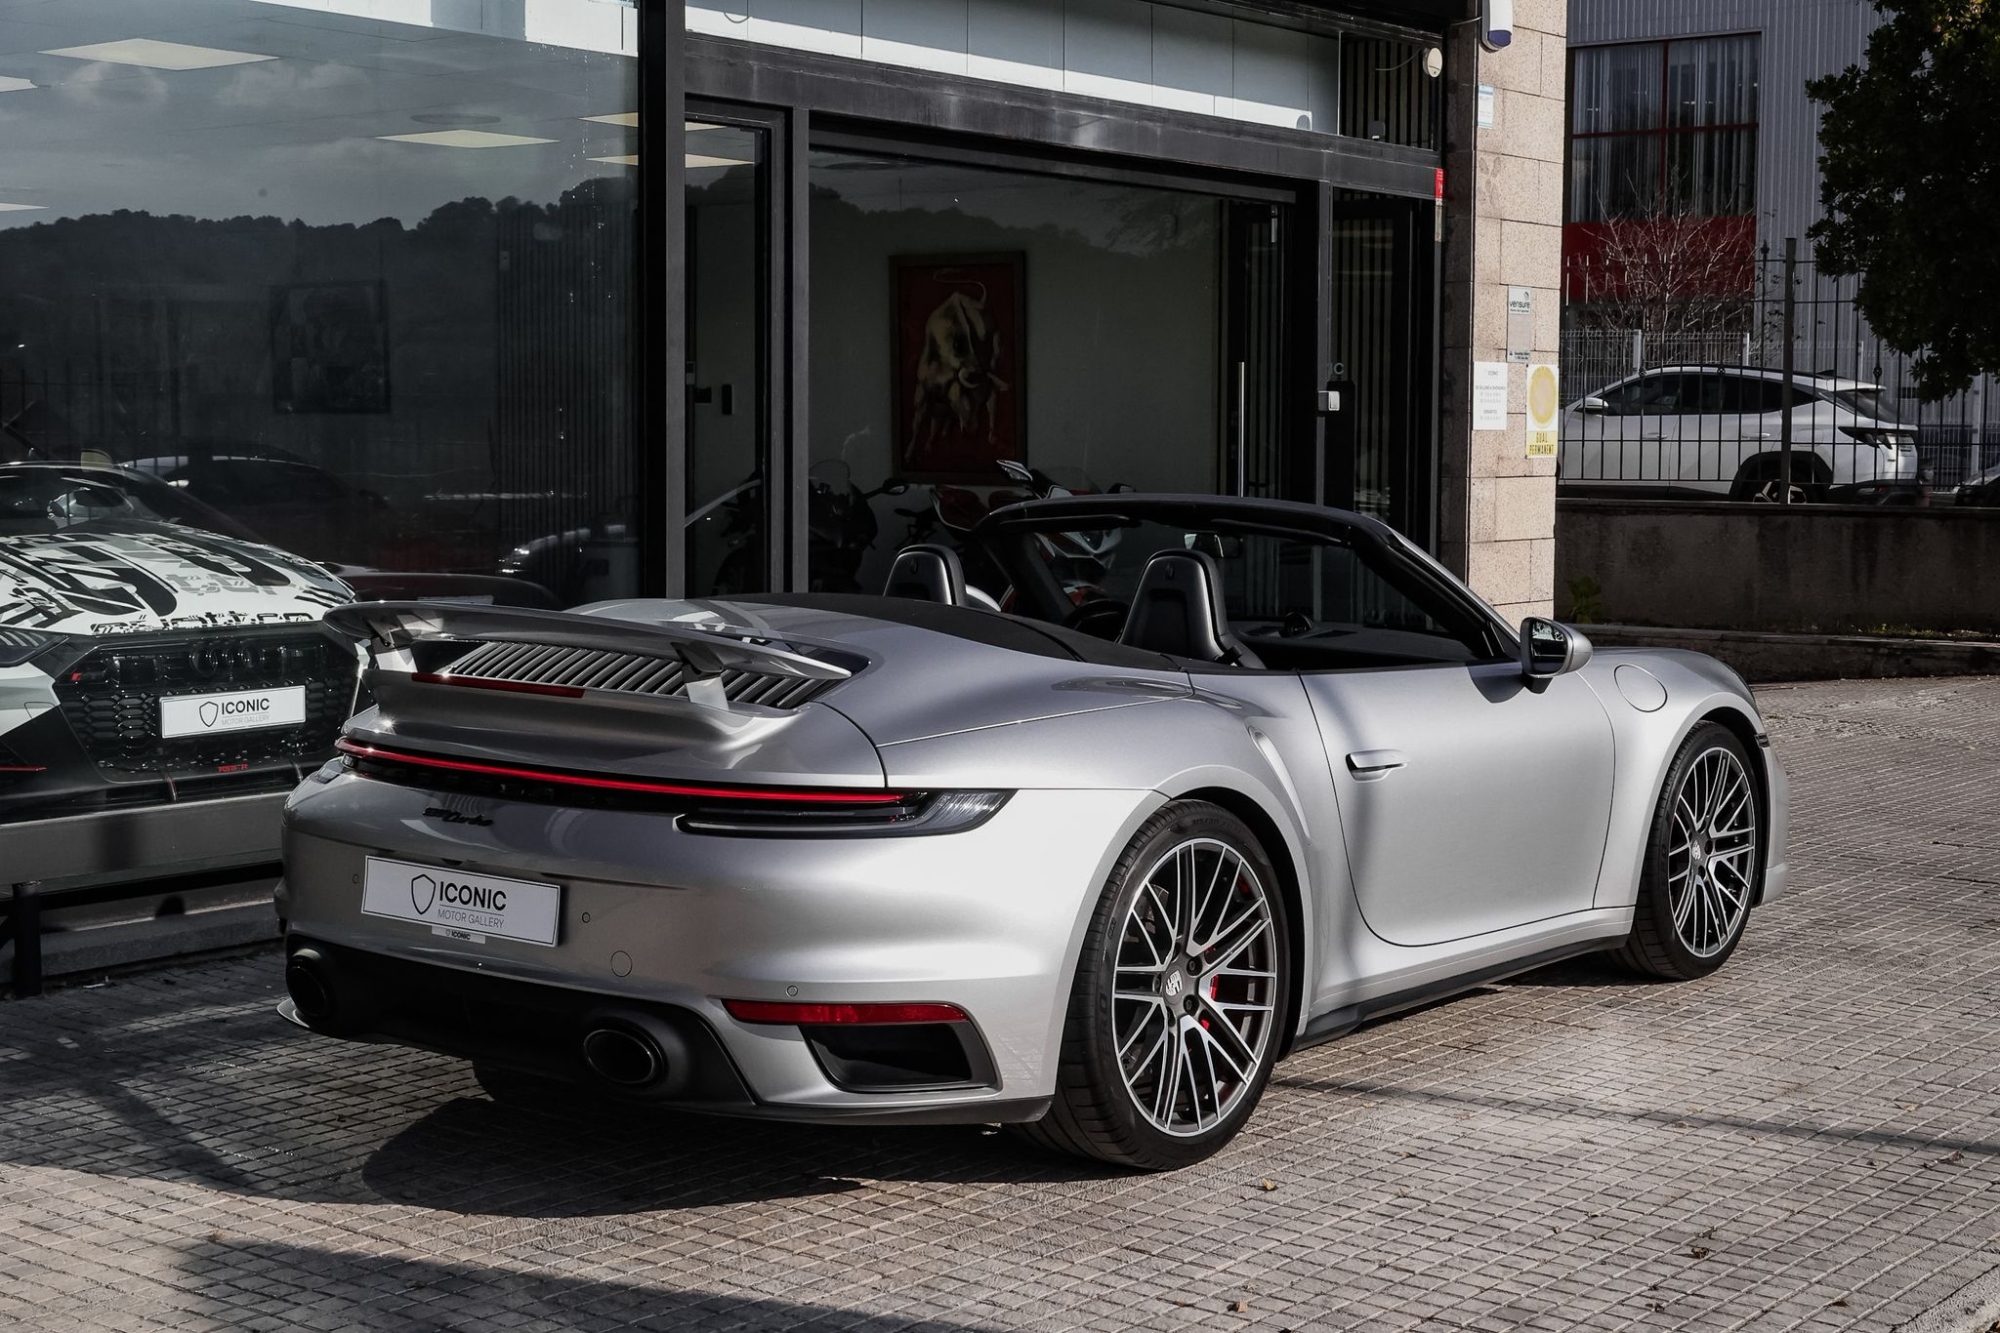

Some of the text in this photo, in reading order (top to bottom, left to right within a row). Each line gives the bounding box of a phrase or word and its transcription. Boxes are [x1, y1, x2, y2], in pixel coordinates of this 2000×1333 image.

[1529, 444, 1554, 455] PERMANENT
[222, 698, 270, 715] ICONIC
[222, 714, 270, 726] MOTOR GALLERY
[439, 881, 507, 911] ICONIC
[437, 909, 505, 928] MOTOR GALLERY
[451, 930, 471, 940] ICONIC
